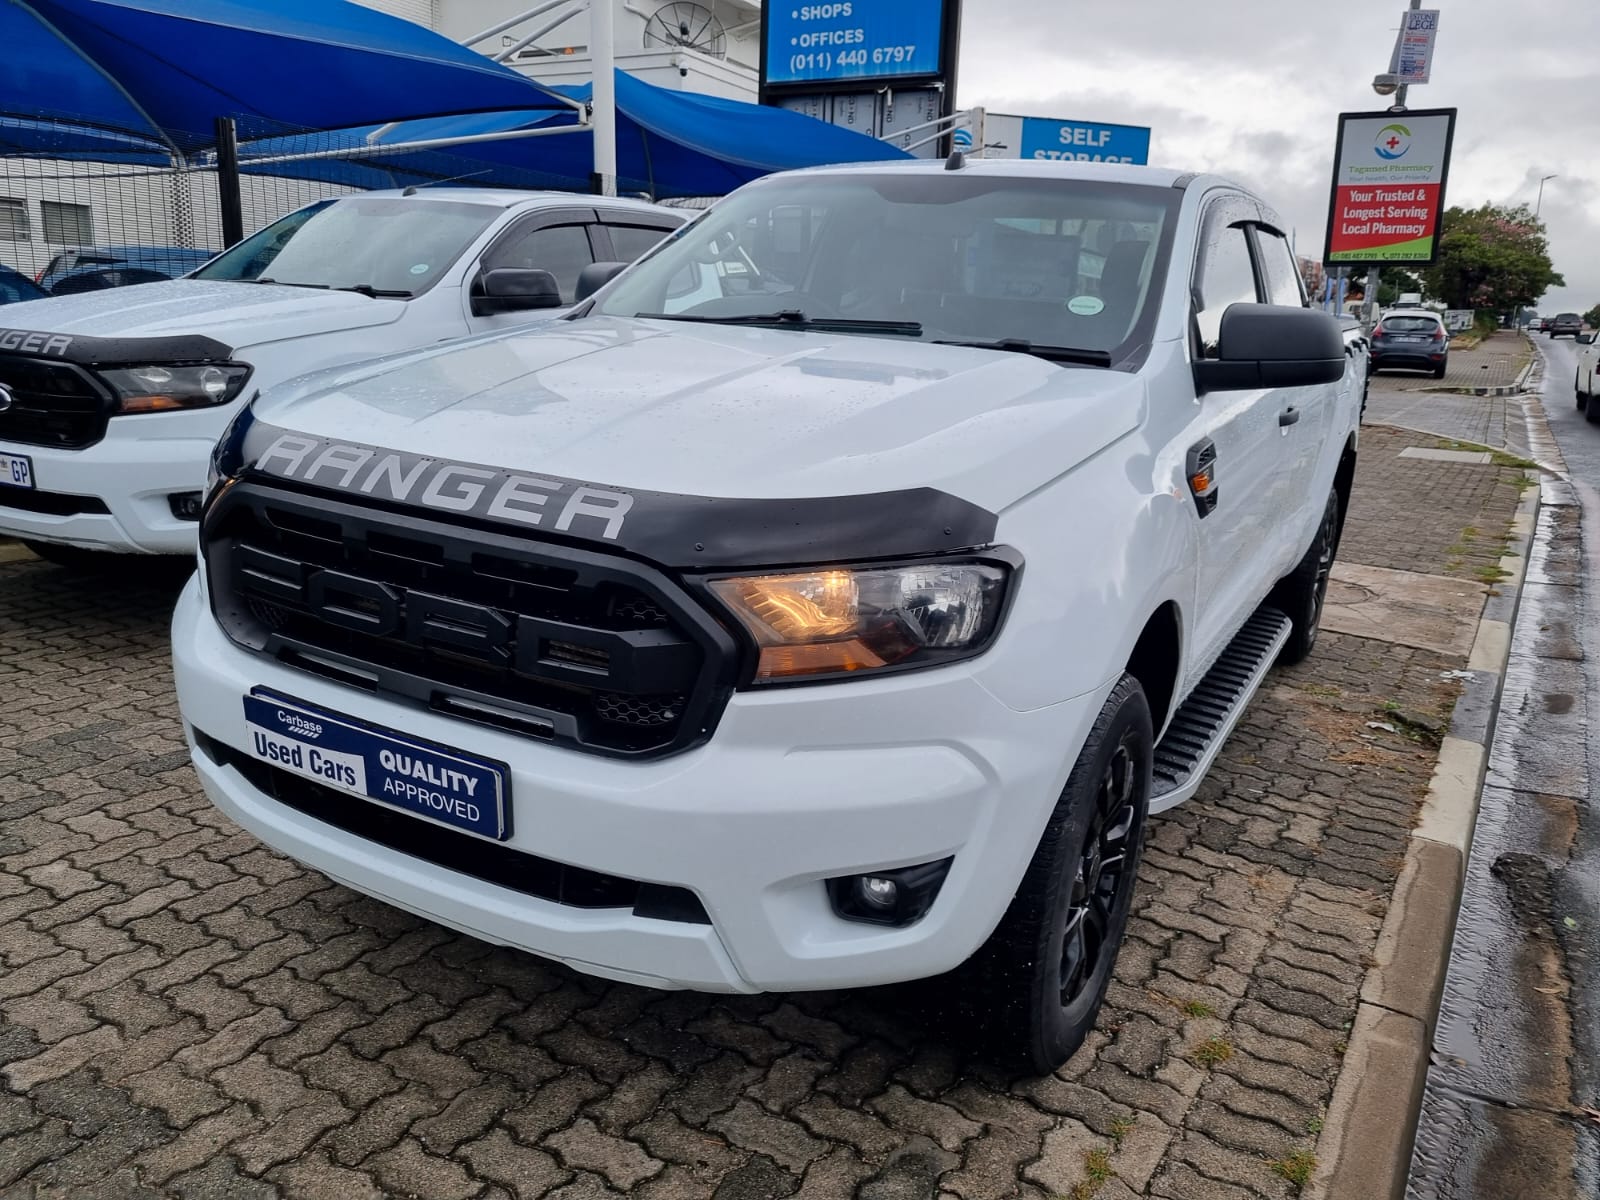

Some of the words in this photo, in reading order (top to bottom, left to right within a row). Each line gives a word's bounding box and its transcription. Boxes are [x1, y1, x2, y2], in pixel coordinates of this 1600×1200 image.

[801, 2, 853, 20] SHOPS
[800, 29, 865, 47] OFFICES
[790, 52, 832, 74] (011)
[836, 49, 868, 66] 440
[872, 45, 916, 64] 6797
[1059, 127, 1112, 147] SELF
[1390, 164, 1434, 173] Pharmacy
[1350, 190, 1373, 202] Your
[1375, 189, 1415, 201] Trusted
[1416, 189, 1426, 201] &
[1343, 207, 1385, 220] Longest
[1387, 206, 1428, 220] Serving
[1342, 223, 1370, 235] Local
[1372, 222, 1425, 236] Pharmacy
[11, 460, 28, 484] GP
[254, 434, 634, 540] RANGER
[277, 710, 323, 734] Carbase
[254, 731, 303, 769] Used
[309, 749, 356, 787] Cars
[379, 749, 478, 796] QUALITY
[383, 777, 480, 822] APPROVED
